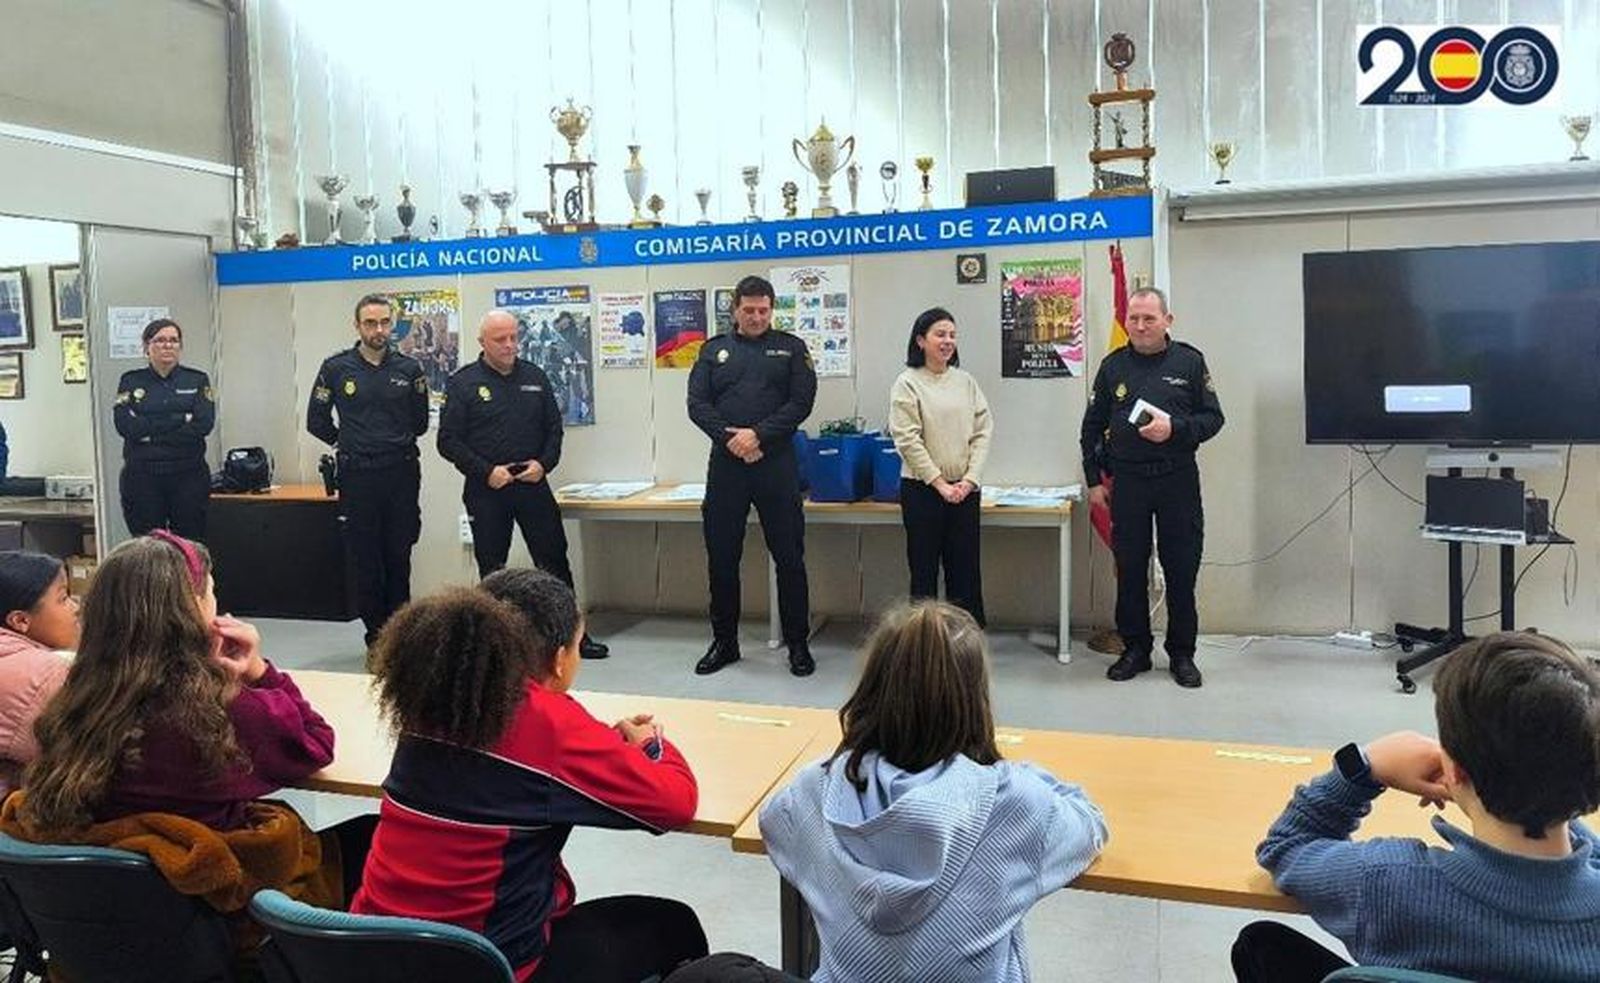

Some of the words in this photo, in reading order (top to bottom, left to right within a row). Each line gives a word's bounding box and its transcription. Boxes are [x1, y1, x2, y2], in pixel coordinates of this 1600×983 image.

[635, 227, 766, 256] COMISARÍA
[777, 225, 926, 249] PROVINCIAL
[940, 220, 973, 239] DE
[988, 211, 1108, 236] ZAMORA
[352, 248, 430, 271] POLICÍA
[438, 246, 543, 266] NACIONAL
